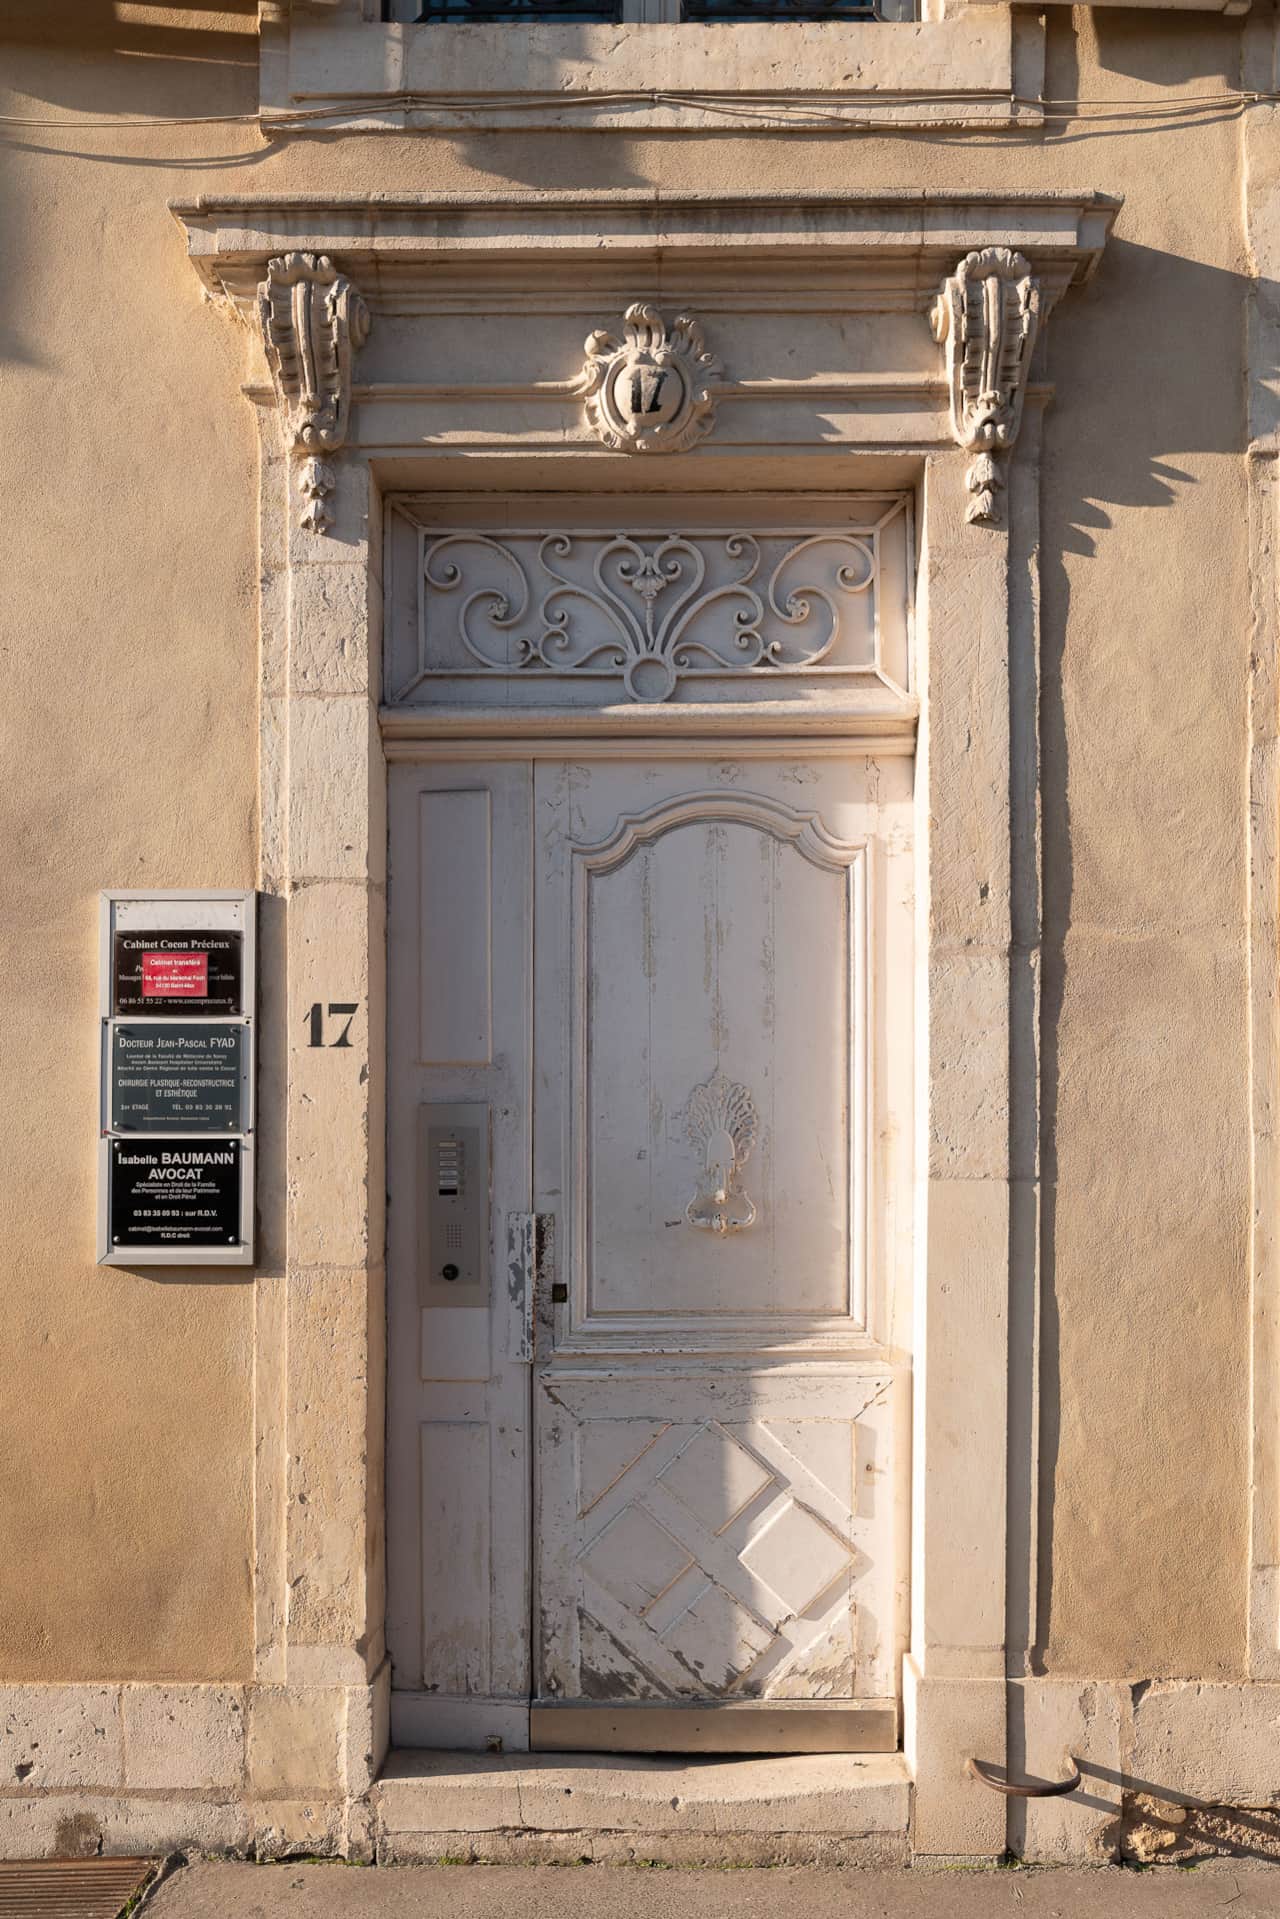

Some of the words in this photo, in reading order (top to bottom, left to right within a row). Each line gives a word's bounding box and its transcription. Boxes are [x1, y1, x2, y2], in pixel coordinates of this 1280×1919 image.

[629, 368, 668, 413] 17
[123, 940, 158, 949] Cabinet
[160, 940, 189, 949] Cocon
[191, 940, 230, 949] Précieux
[303, 1003, 359, 1048] 17
[119, 1038, 154, 1048] DOCTEUR
[156, 1038, 208, 1048] JEAN-PASCAL
[210, 1038, 235, 1048] FYAD
[118, 1079, 149, 1088] CHIRURGIE
[155, 1089, 162, 1097] ET
[164, 1089, 198, 1097] ESTHÉTIQUE
[118, 1152, 158, 1165] Isabelle
[161, 1152, 234, 1165] BAUMANN
[148, 1168, 204, 1180] AVOCAT
